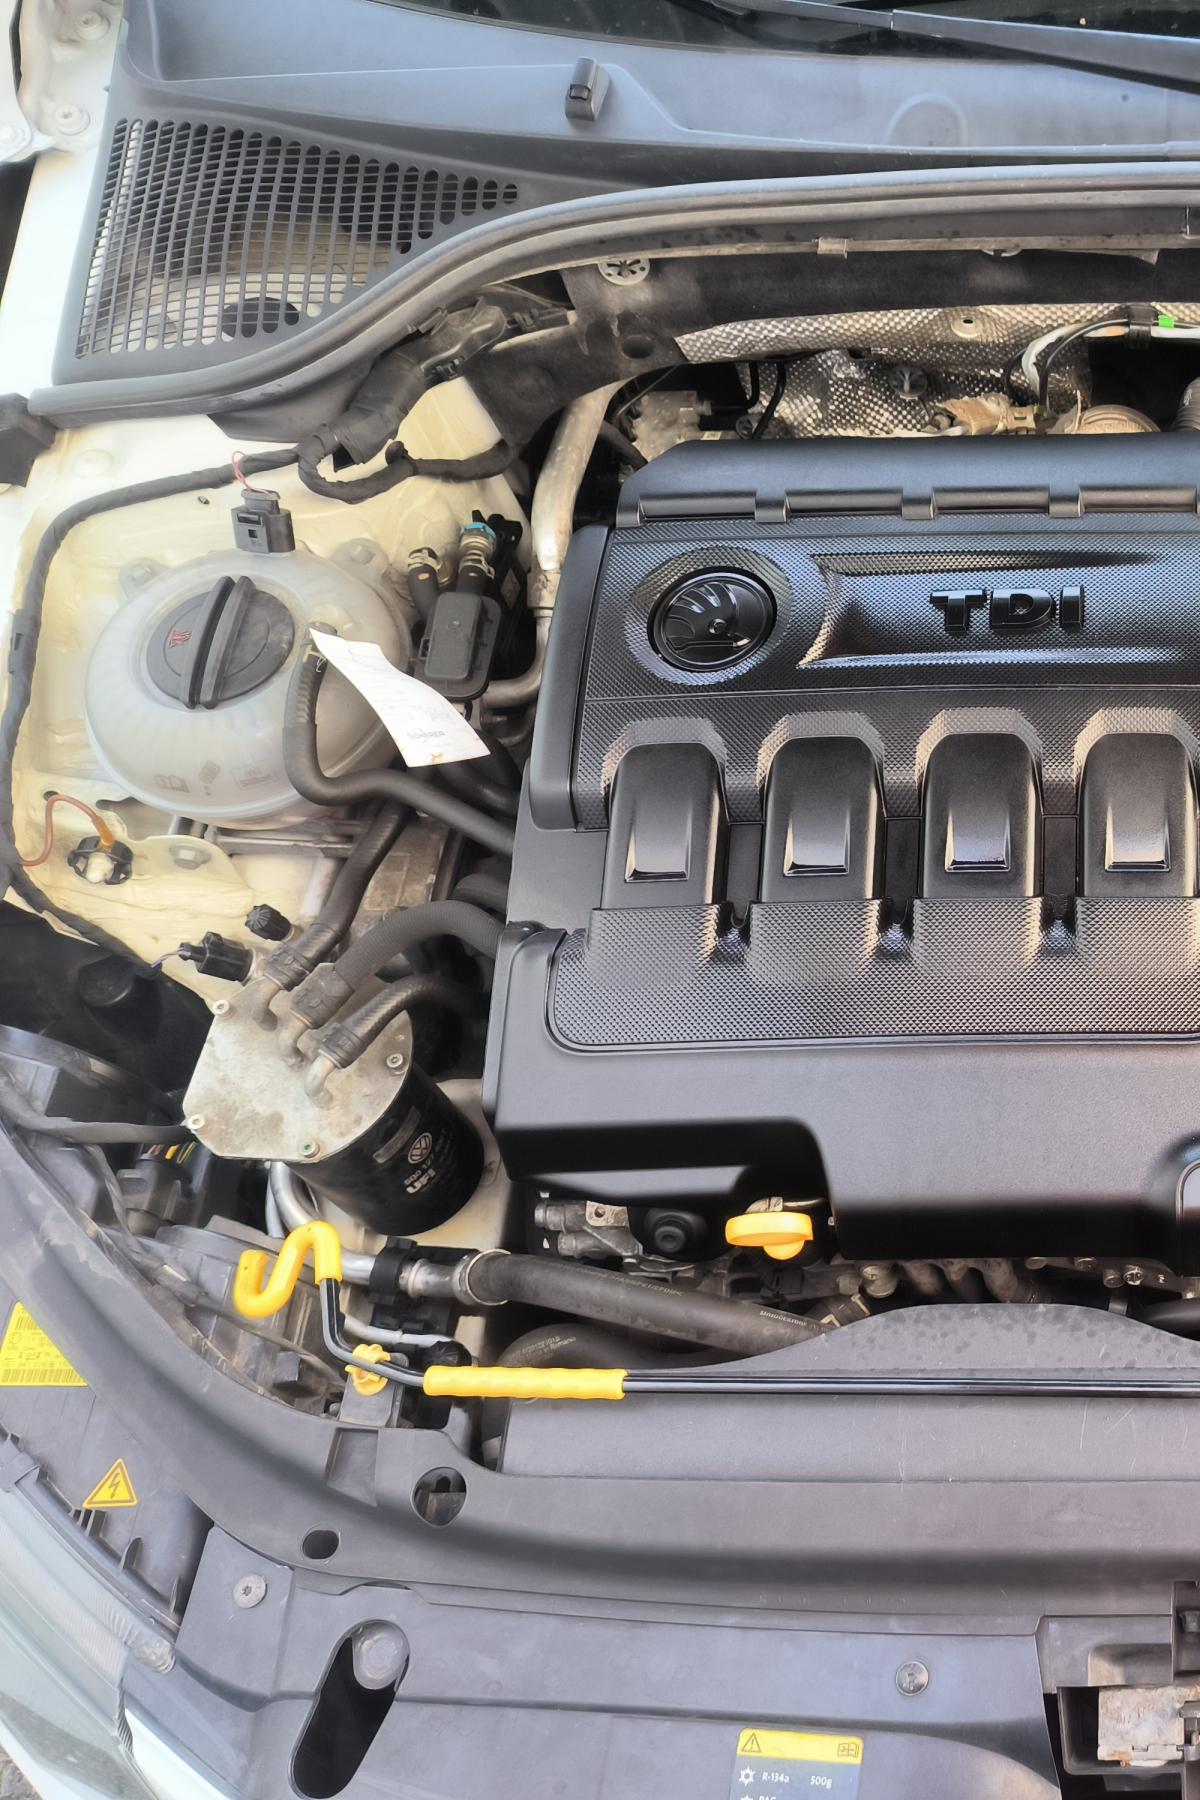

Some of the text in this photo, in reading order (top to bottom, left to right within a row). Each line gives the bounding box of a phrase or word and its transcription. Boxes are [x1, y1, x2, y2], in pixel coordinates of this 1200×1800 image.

[930, 586, 1085, 632] TDI
[406, 1168, 436, 1194] UFI
[761, 1771, 833, 1790] R-134a 500g
